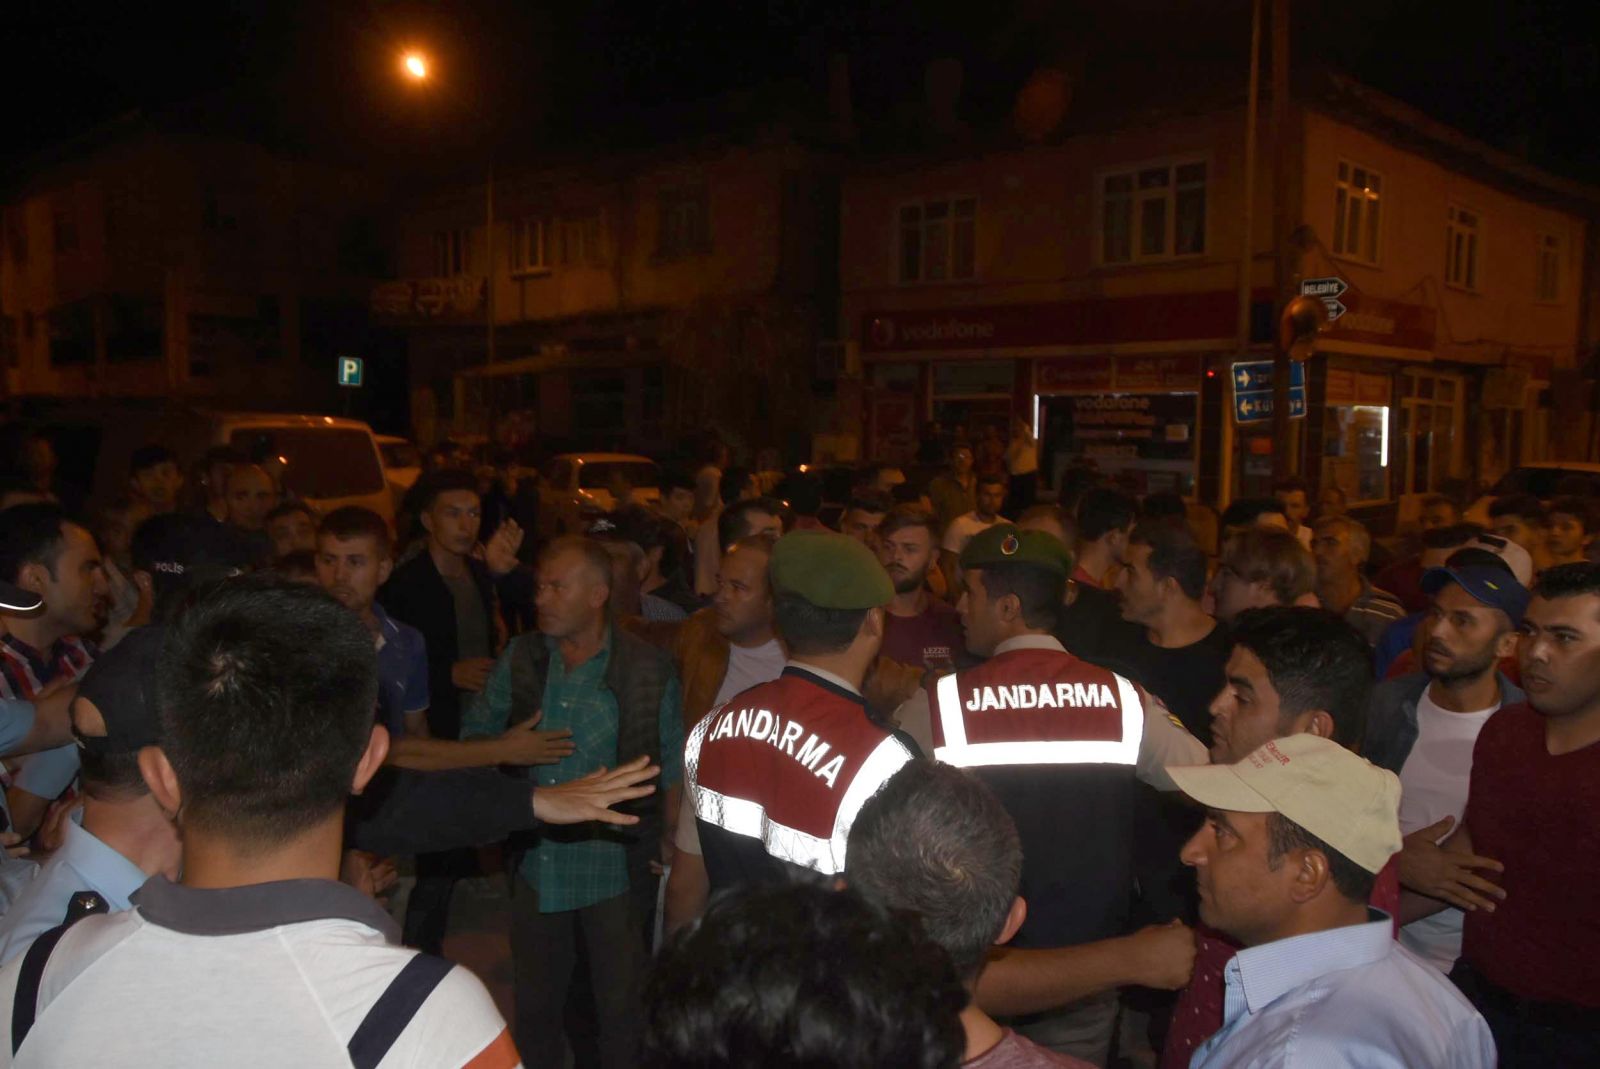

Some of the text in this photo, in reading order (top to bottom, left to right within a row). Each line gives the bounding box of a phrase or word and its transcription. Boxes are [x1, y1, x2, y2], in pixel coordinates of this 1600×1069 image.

[343, 359, 358, 382] P
[964, 682, 1118, 712] JANDARMA
[709, 708, 847, 789] JANDARMA
